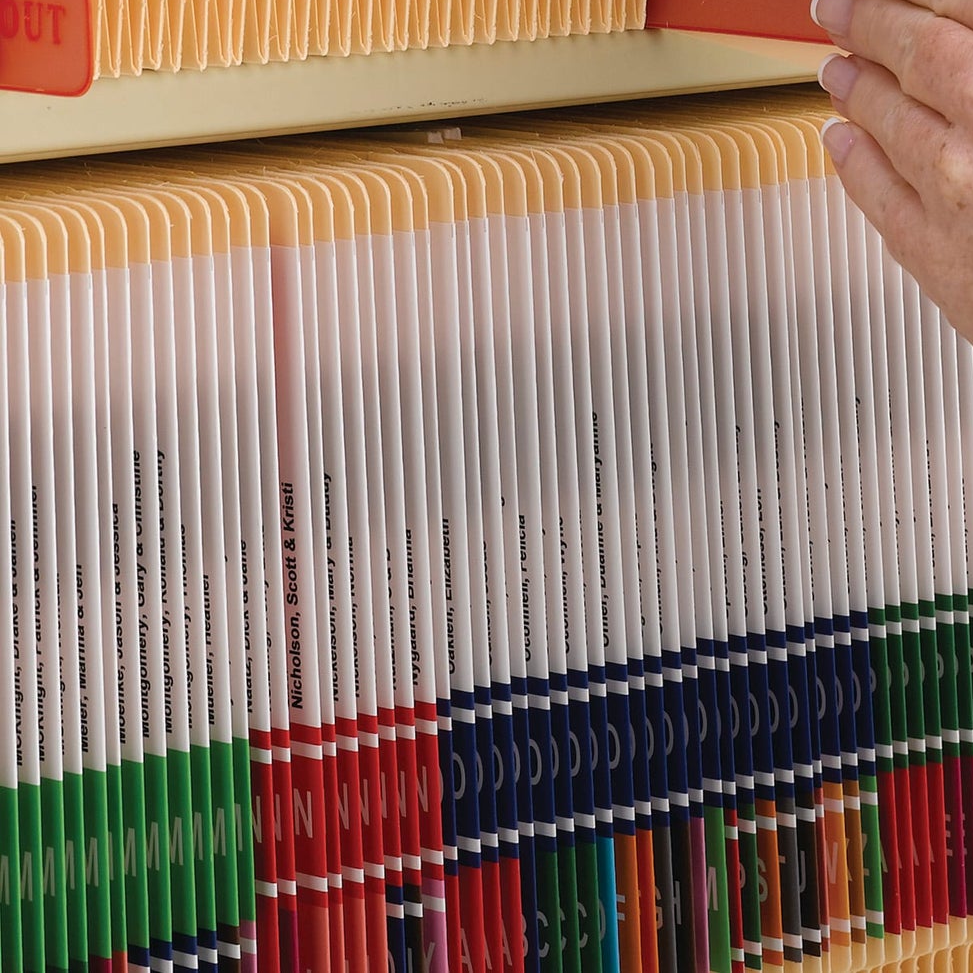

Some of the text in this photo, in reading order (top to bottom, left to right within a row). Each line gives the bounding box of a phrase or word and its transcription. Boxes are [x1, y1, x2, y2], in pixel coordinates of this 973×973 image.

[136, 542, 143, 556] &
[114, 581, 121, 596] &
[282, 482, 303, 709] Nicholson, Scott & Kristi
[77, 606, 84, 619] &
[294, 788, 313, 839] N
